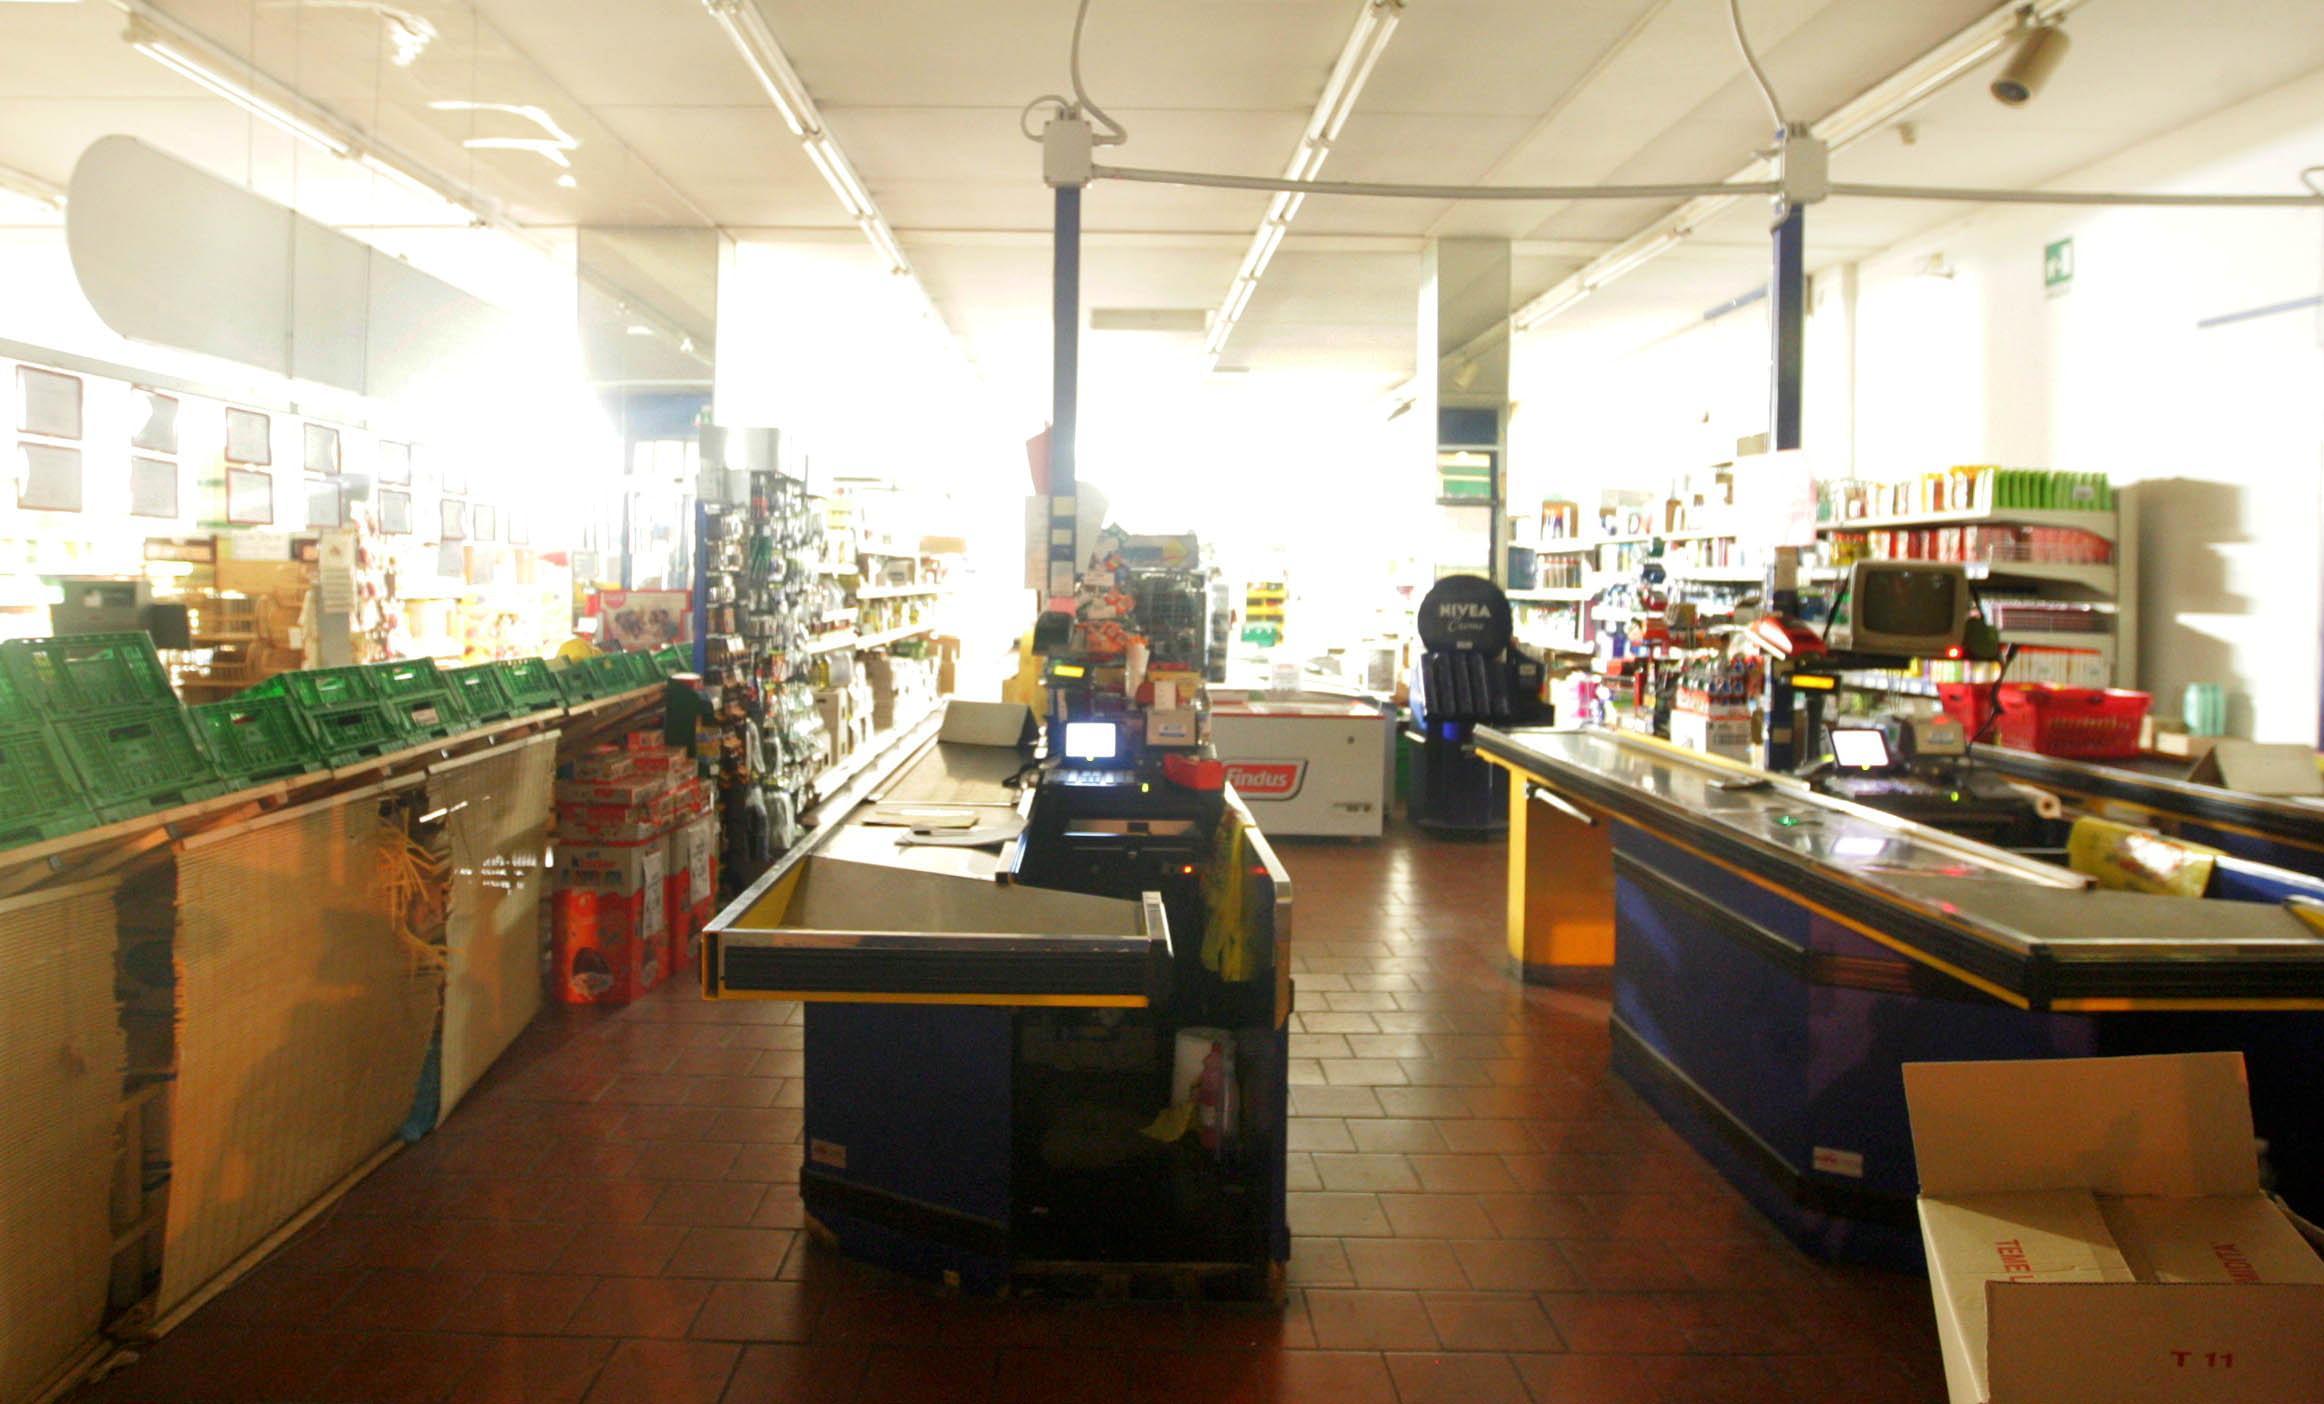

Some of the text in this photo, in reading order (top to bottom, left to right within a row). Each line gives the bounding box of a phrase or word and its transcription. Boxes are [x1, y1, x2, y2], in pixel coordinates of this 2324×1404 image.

[1439, 603, 1491, 617] NIVEA
[1226, 768, 1288, 787] Findus
[2170, 1350, 2233, 1368] T 11
